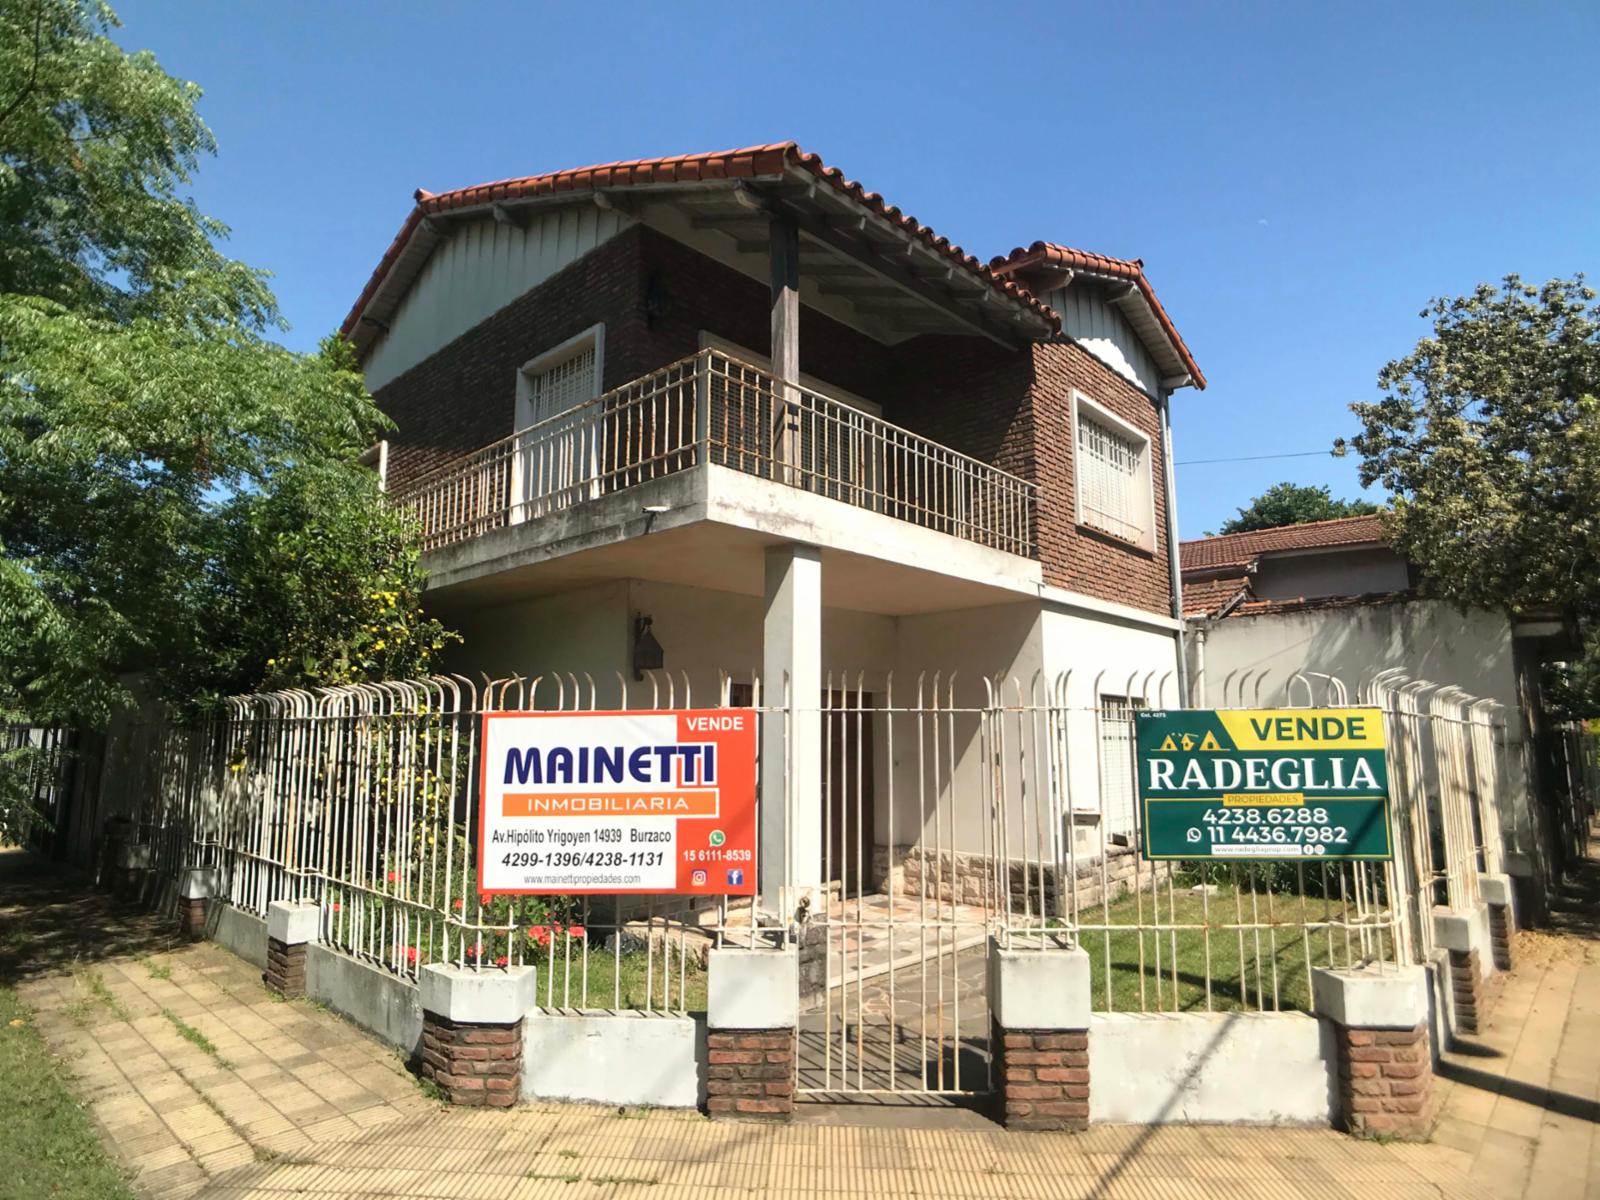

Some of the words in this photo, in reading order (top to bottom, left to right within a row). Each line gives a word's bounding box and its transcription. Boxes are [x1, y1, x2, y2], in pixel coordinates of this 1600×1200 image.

[686, 716, 744, 731] VENDE
[1250, 717, 1367, 741] VENDE
[503, 745, 714, 785] MAINETTI
[1146, 757, 1382, 790] RADEGLIA
[528, 797, 689, 812] INMOBILIARIA
[1227, 795, 1299, 804] PROPIEDADES
[1202, 807, 1328, 825] 4238.6288
[492, 829, 545, 846] Av.Hipólito
[547, 829, 591, 846] Yrigoyen
[593, 829, 622, 843] 14939
[630, 828, 672, 843] Burzaco
[1207, 827, 1225, 843] 11
[1231, 826, 1348, 843] 4436.7982
[683, 850, 695, 861] 15
[697, 850, 752, 861] 6111-8539
[1214, 845, 1300, 854] www.radegliaprop.com
[501, 852, 664, 867] 4299-1396/4238-1131
[523, 873, 641, 886] www.mainettipropiedades.com
